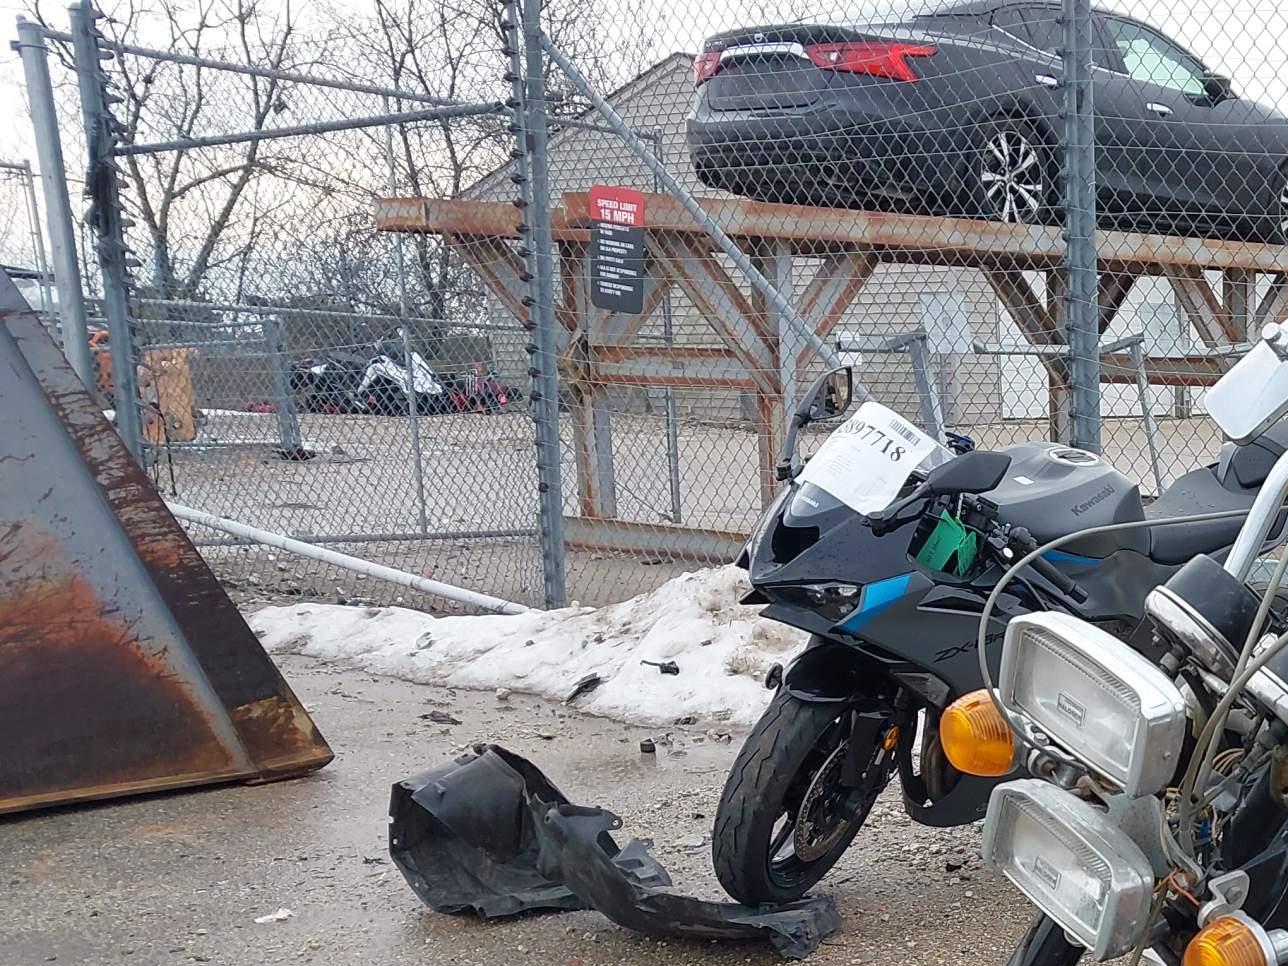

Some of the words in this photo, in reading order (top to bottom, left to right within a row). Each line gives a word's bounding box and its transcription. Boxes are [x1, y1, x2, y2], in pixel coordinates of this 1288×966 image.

[597, 198, 619, 209] SPEED
[619, 202, 638, 213] LIMIT
[600, 208, 611, 220] 15
[613, 210, 635, 224] MPH
[1071, 483, 1116, 517] Kawasaki
